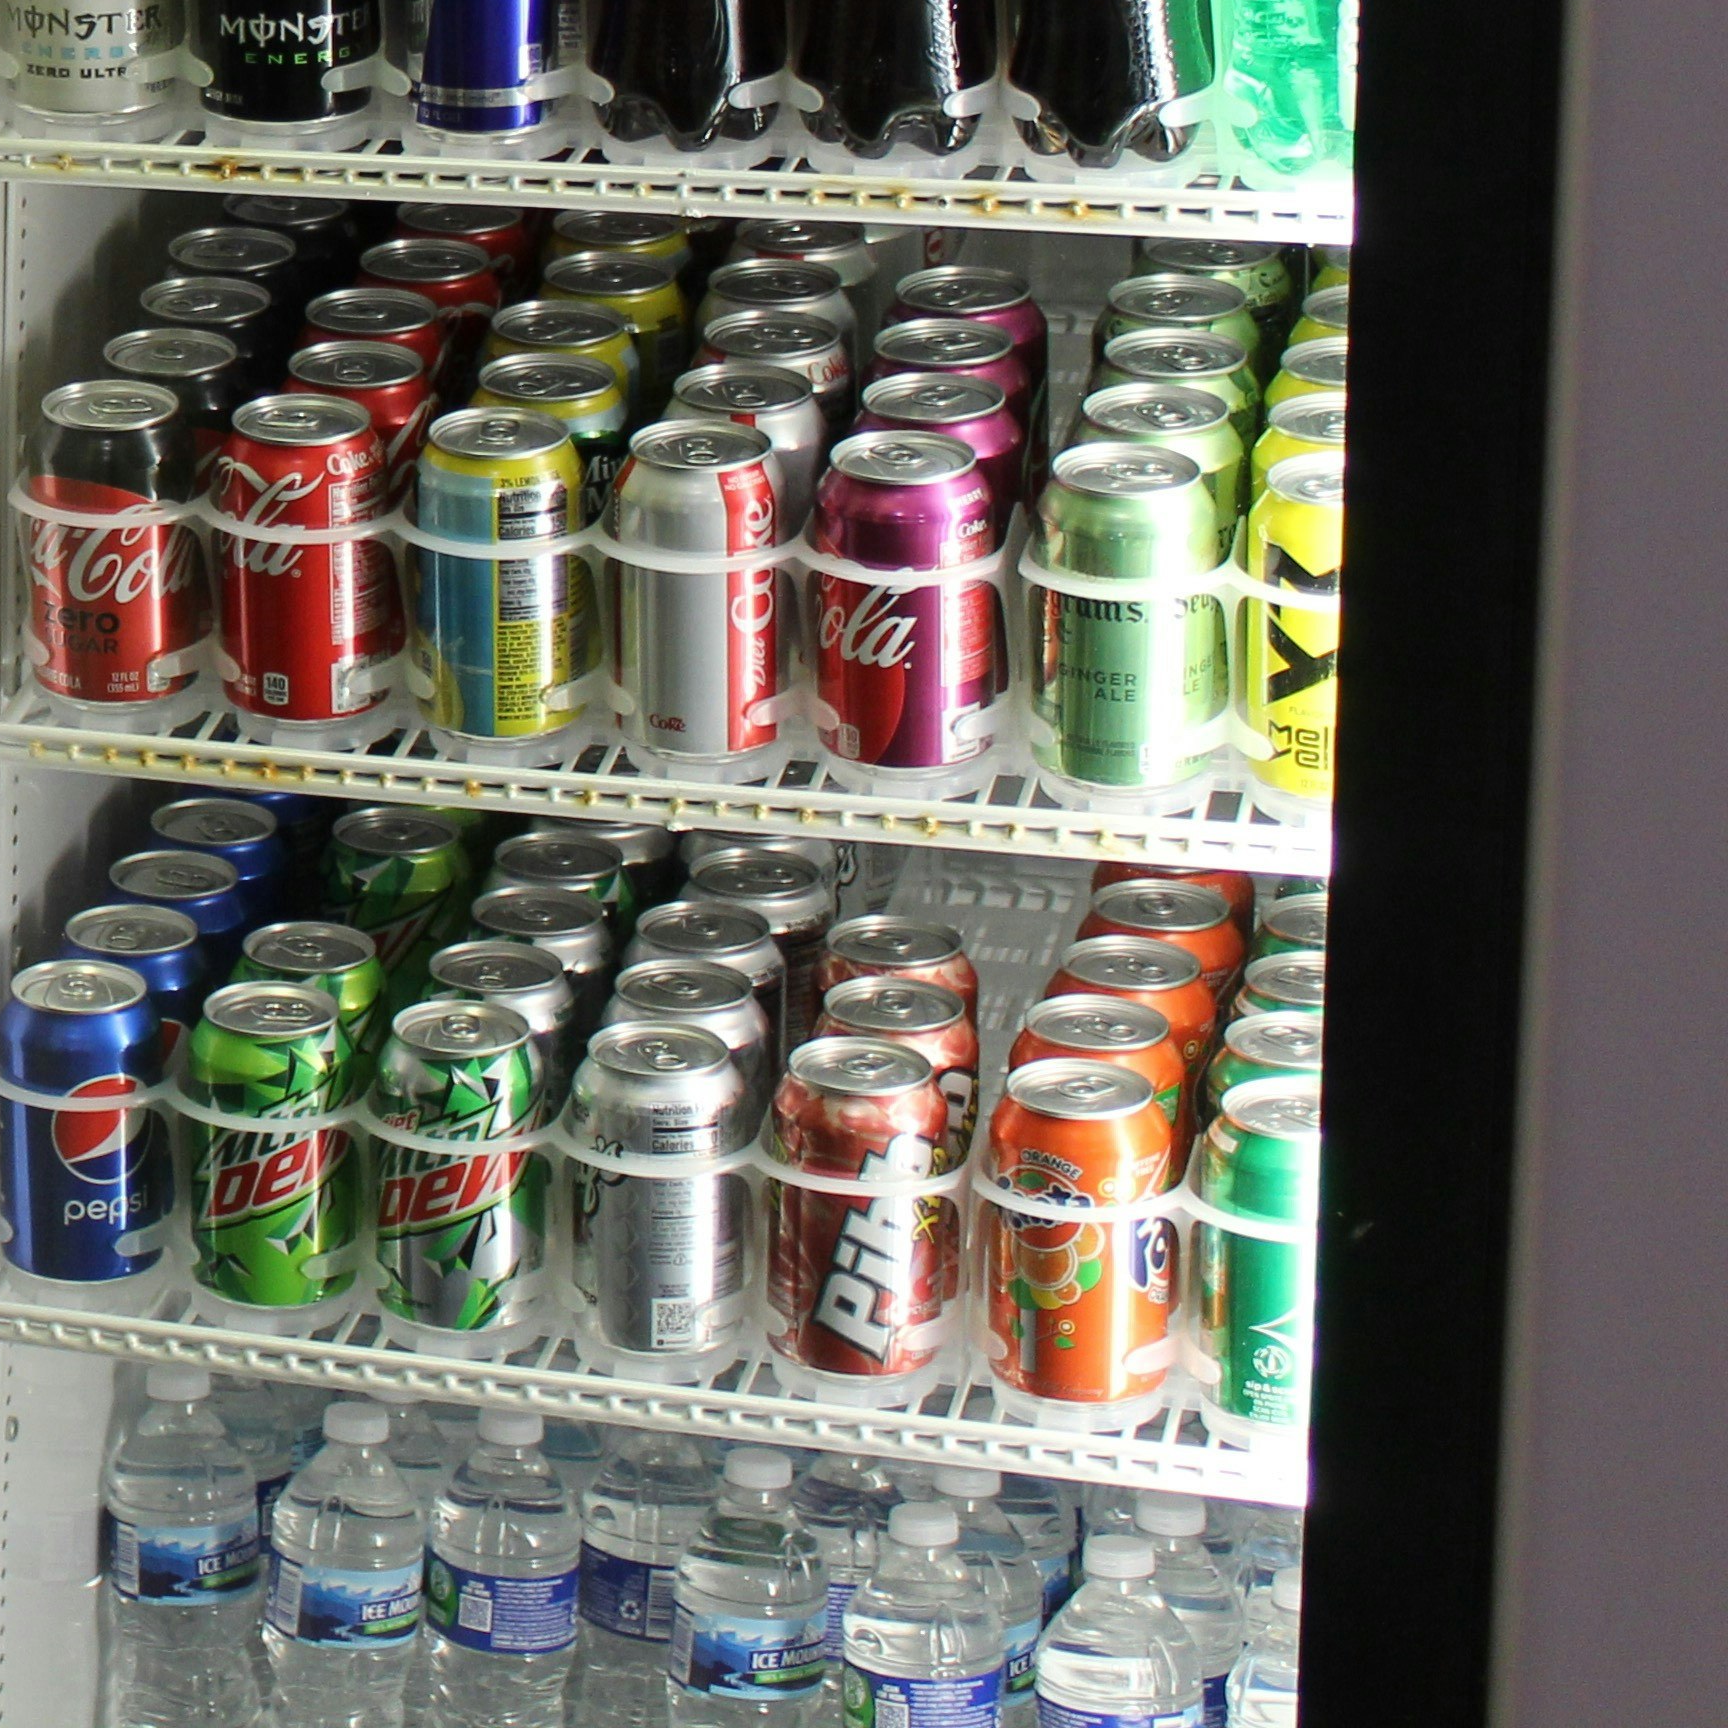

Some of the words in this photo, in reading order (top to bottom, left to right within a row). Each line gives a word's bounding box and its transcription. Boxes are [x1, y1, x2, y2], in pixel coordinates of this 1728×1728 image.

[7, 4, 162, 36] MONSTER
[25, 64, 71, 81] ZERO
[326, 449, 370, 476] Coke
[499, 492, 542, 504] Nutrition
[957, 518, 988, 541] Coke
[266, 676, 286, 690] 140
[1058, 663, 1137, 687] GINGER
[1094, 688, 1137, 703] ALE
[649, 713, 688, 734] Coke
[652, 1105, 693, 1116] Nutrition
[652, 1139, 694, 1151] Calories
[1021, 1148, 1083, 1180] ORANGE
[63, 1191, 149, 1226] pepsi
[198, 1555, 222, 1576] ICE
[361, 1602, 388, 1622] ICE
[751, 1650, 779, 1670] ICE
